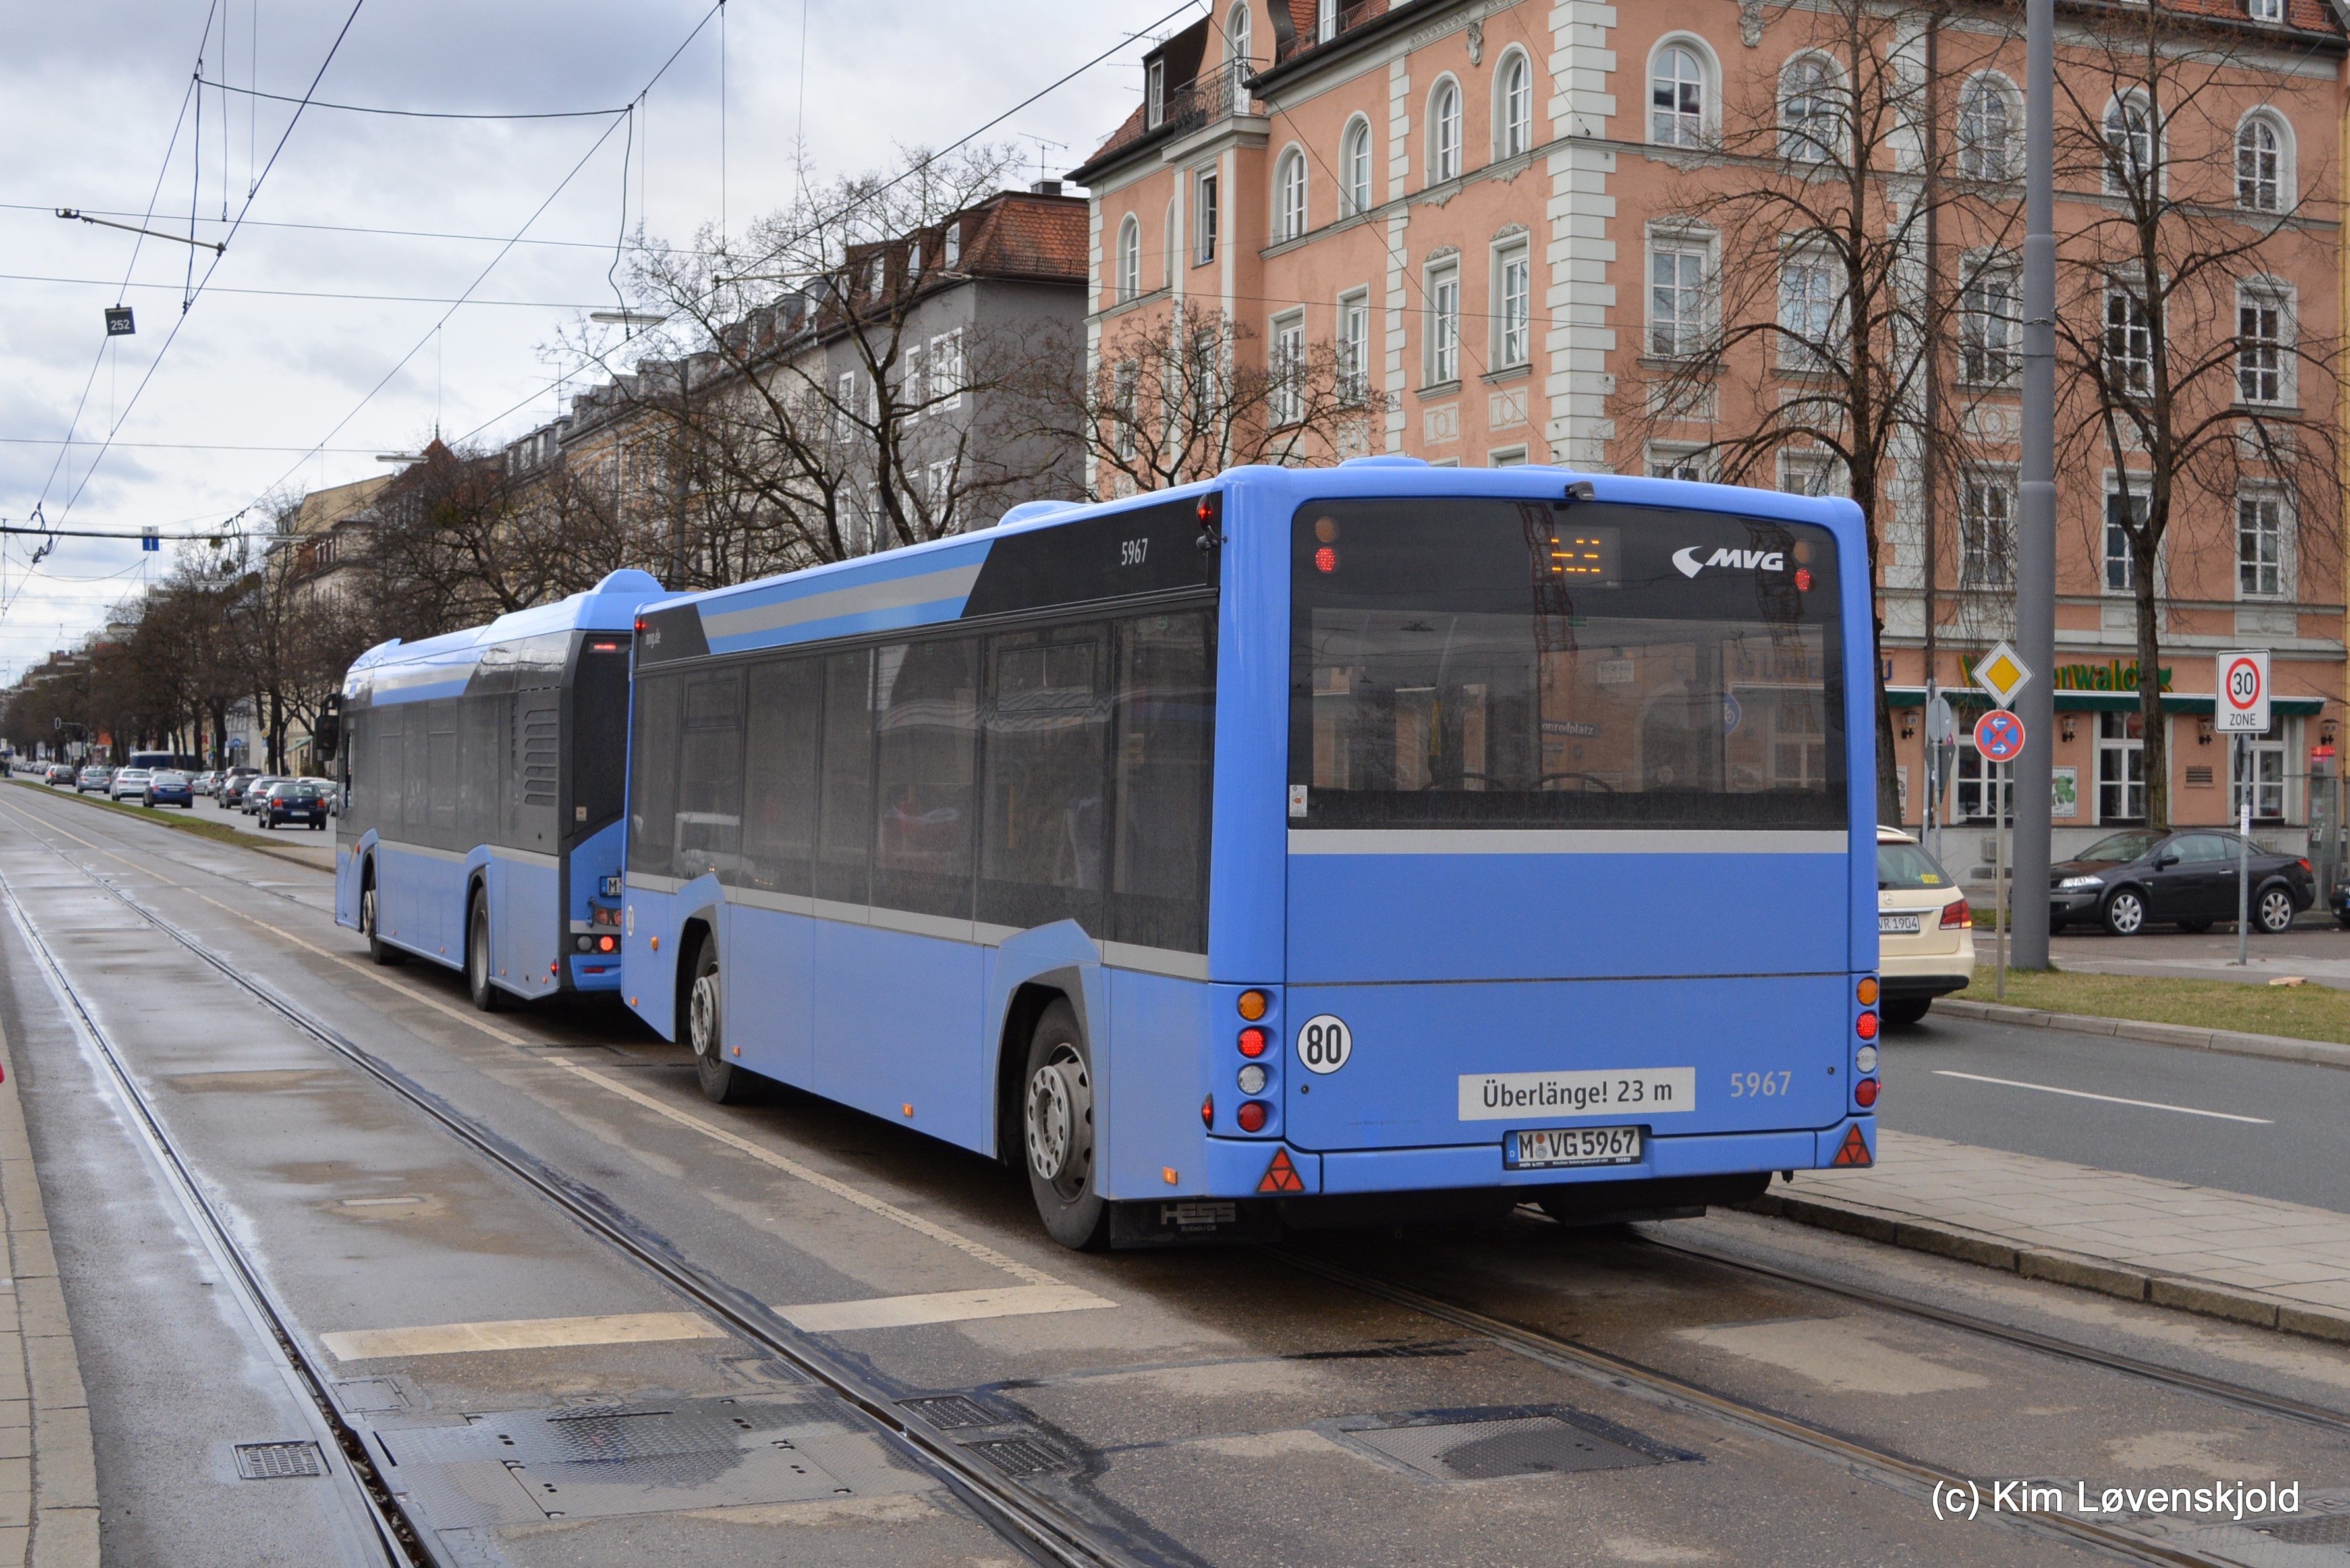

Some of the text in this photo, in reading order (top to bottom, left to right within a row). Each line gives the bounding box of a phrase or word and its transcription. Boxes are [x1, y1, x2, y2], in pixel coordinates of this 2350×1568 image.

[111, 319, 130, 331] 252
[1121, 538, 1148, 566] 5967
[1704, 548, 1783, 571] MVG
[2233, 672, 2253, 696] 30
[1541, 722, 1594, 735] onrodplatz
[2229, 713, 2256, 726] ZONE
[609, 879, 617, 892] M
[1893, 918, 1917, 929] 1904
[1306, 1024, 1342, 1065] 80
[1483, 1078, 1673, 1110] Überlänge! 23 m
[1730, 1071, 1792, 1098] 5967
[1519, 1134, 1534, 1159] M
[1582, 1129, 1636, 1156] 5967
[1161, 1202, 1236, 1225] HESS
